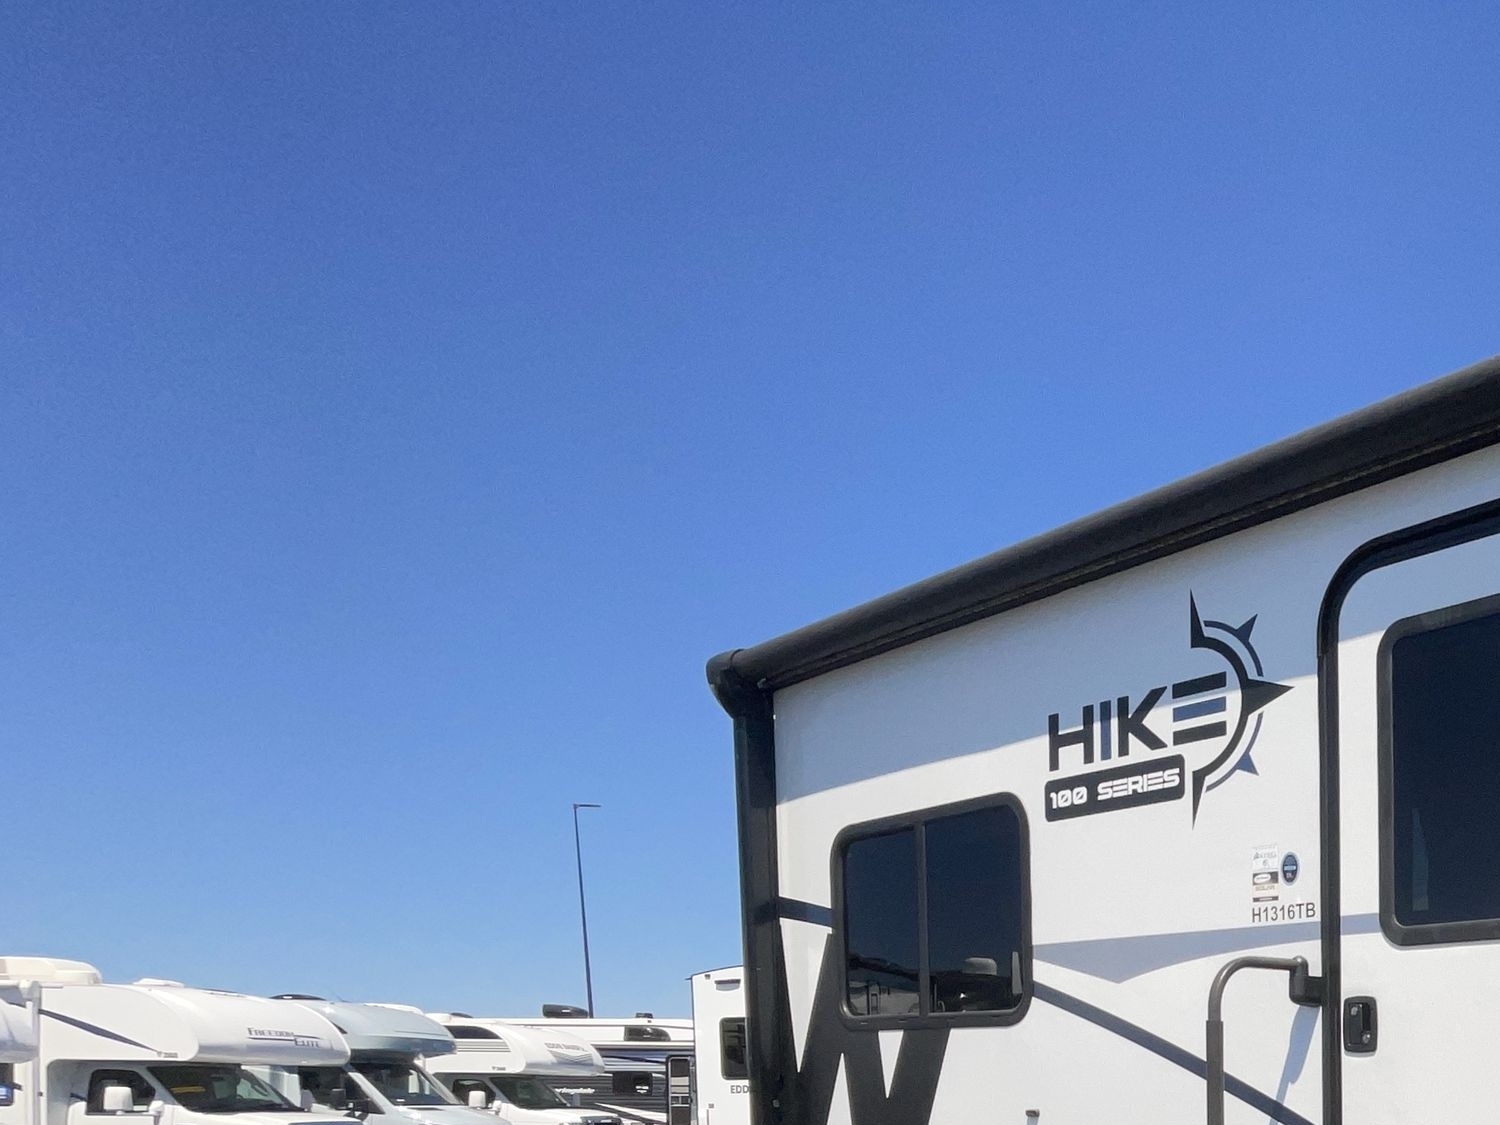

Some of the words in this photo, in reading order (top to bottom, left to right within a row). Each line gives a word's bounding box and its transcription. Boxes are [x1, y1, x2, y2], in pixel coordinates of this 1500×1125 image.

[1048, 671, 1227, 772] HIKE
[1050, 786, 1088, 809] 100
[1097, 767, 1181, 801] SERIES
[1252, 902, 1316, 923] H1316TB
